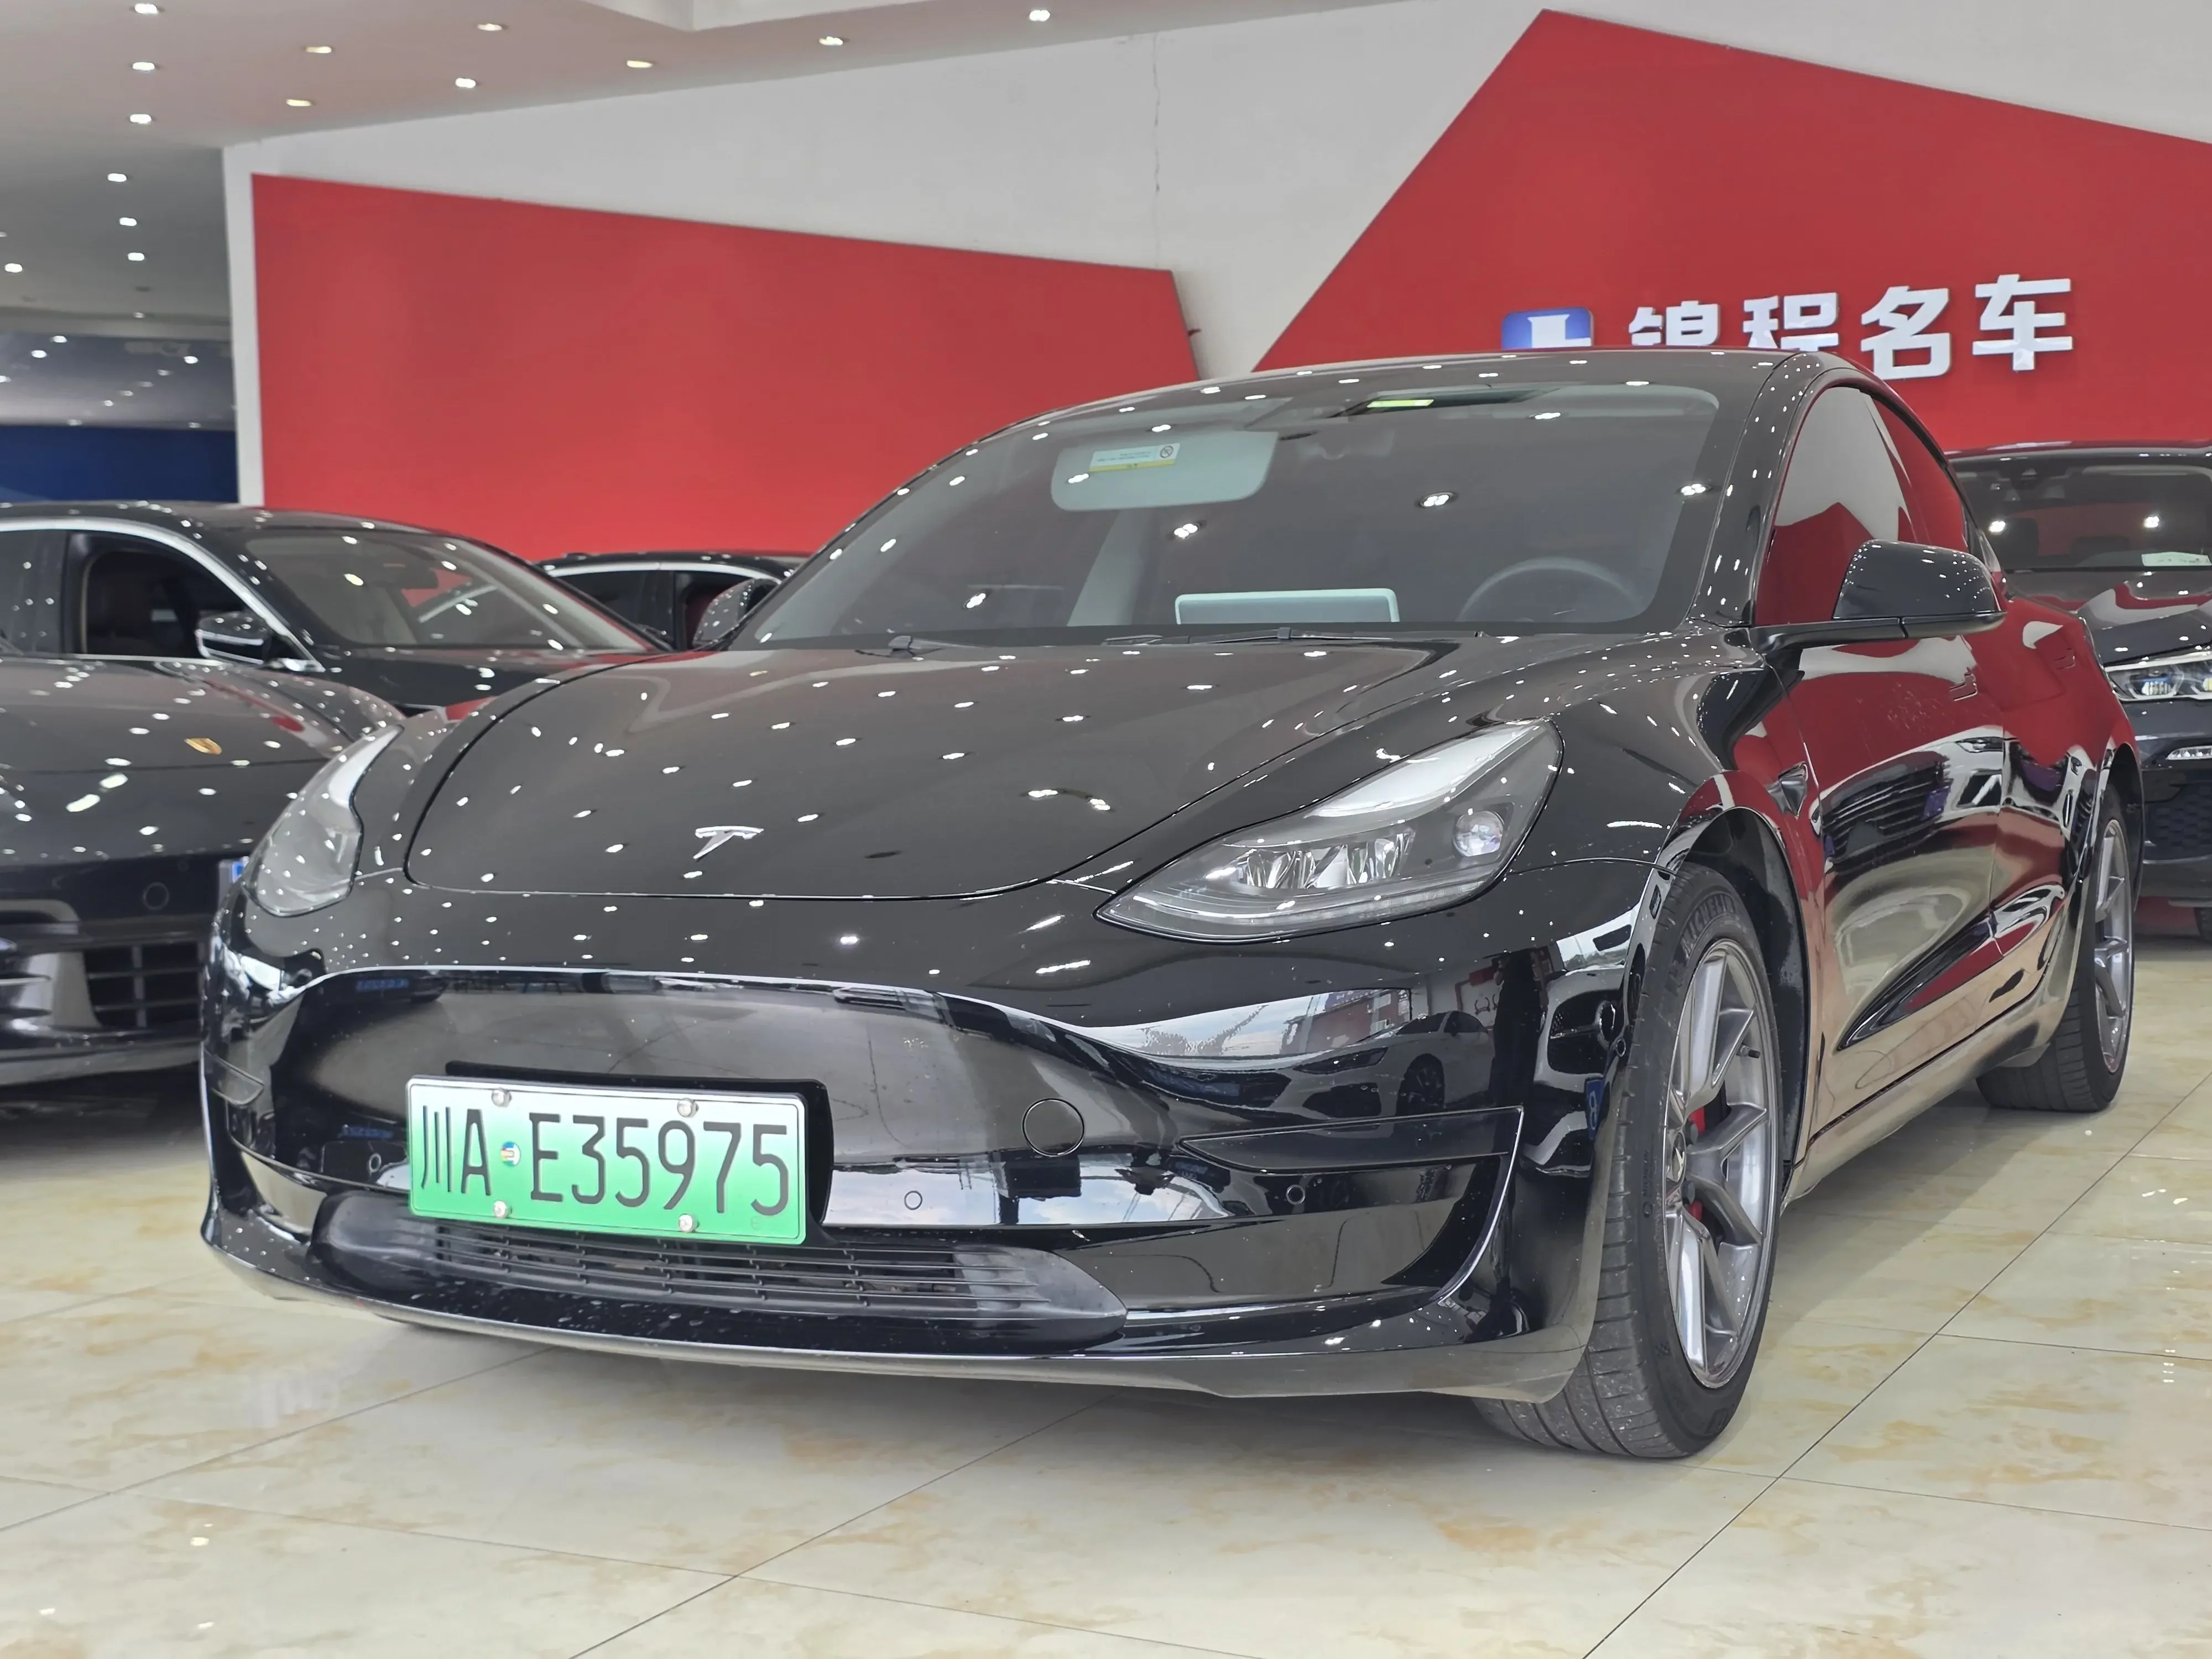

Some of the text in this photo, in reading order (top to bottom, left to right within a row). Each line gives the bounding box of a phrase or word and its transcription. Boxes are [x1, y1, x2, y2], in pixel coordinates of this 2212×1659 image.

[1679, 893, 1736, 961] MICHELIN
[420, 1105, 789, 1216] 川A E35975
